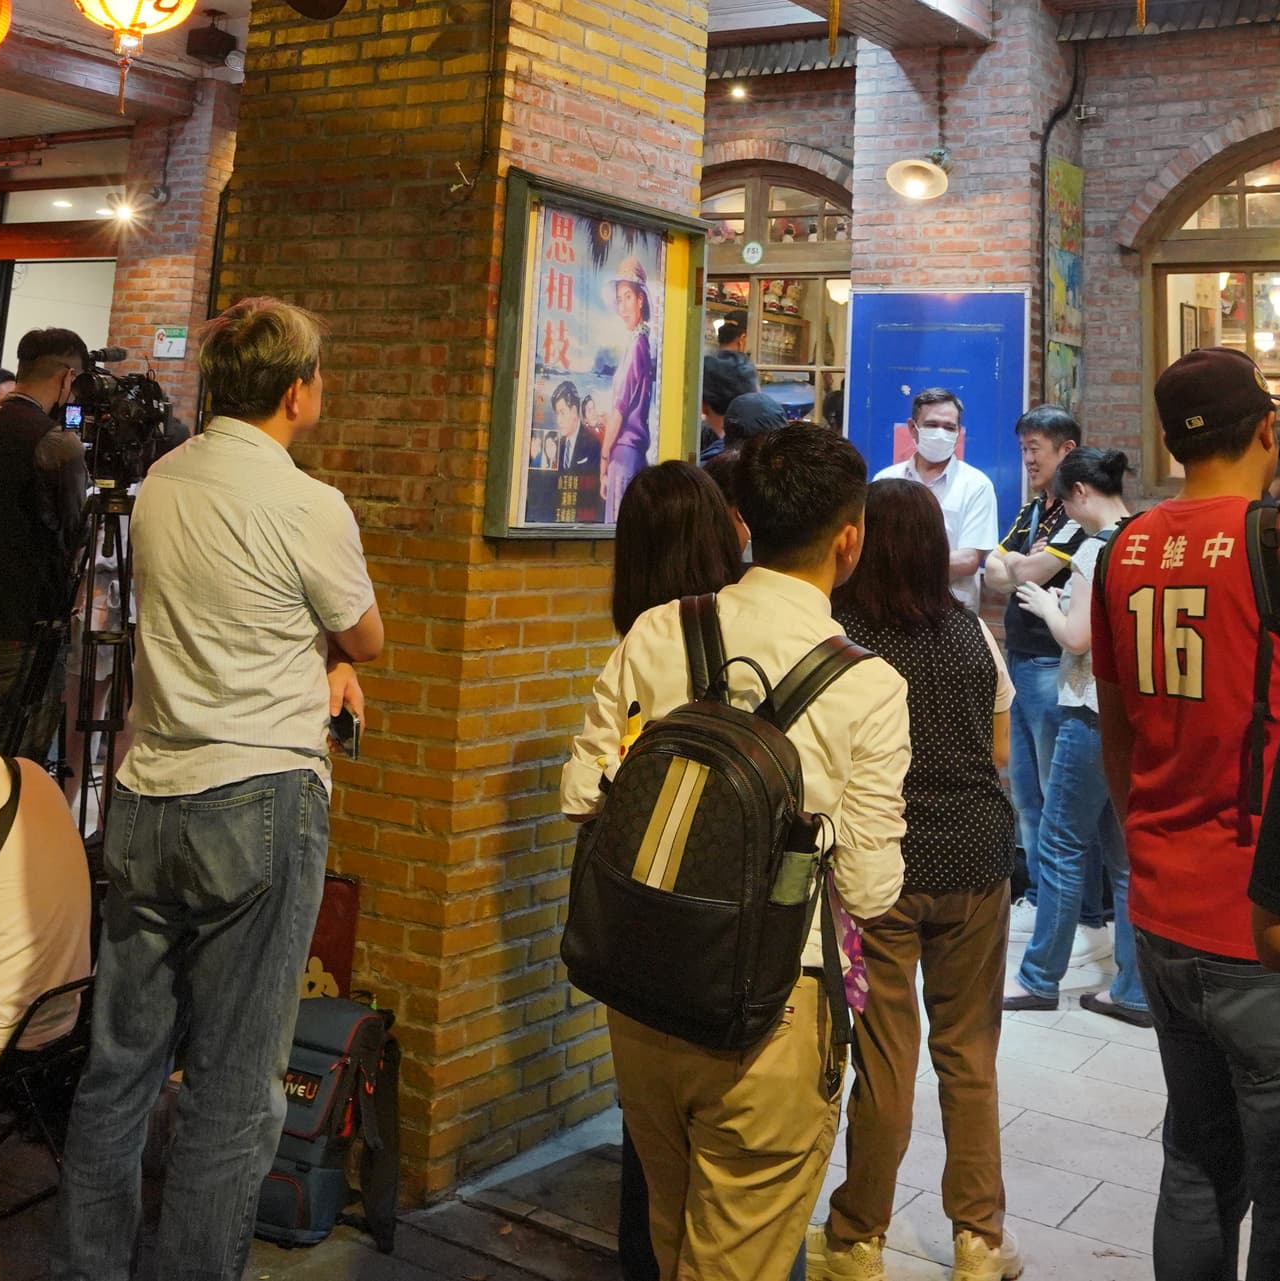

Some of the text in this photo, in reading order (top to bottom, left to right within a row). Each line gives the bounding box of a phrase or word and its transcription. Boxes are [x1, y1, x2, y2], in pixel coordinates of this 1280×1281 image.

[542, 211, 577, 370] 思相枝
[1120, 531, 1235, 570] 王維中
[1128, 584, 1208, 702] 16
